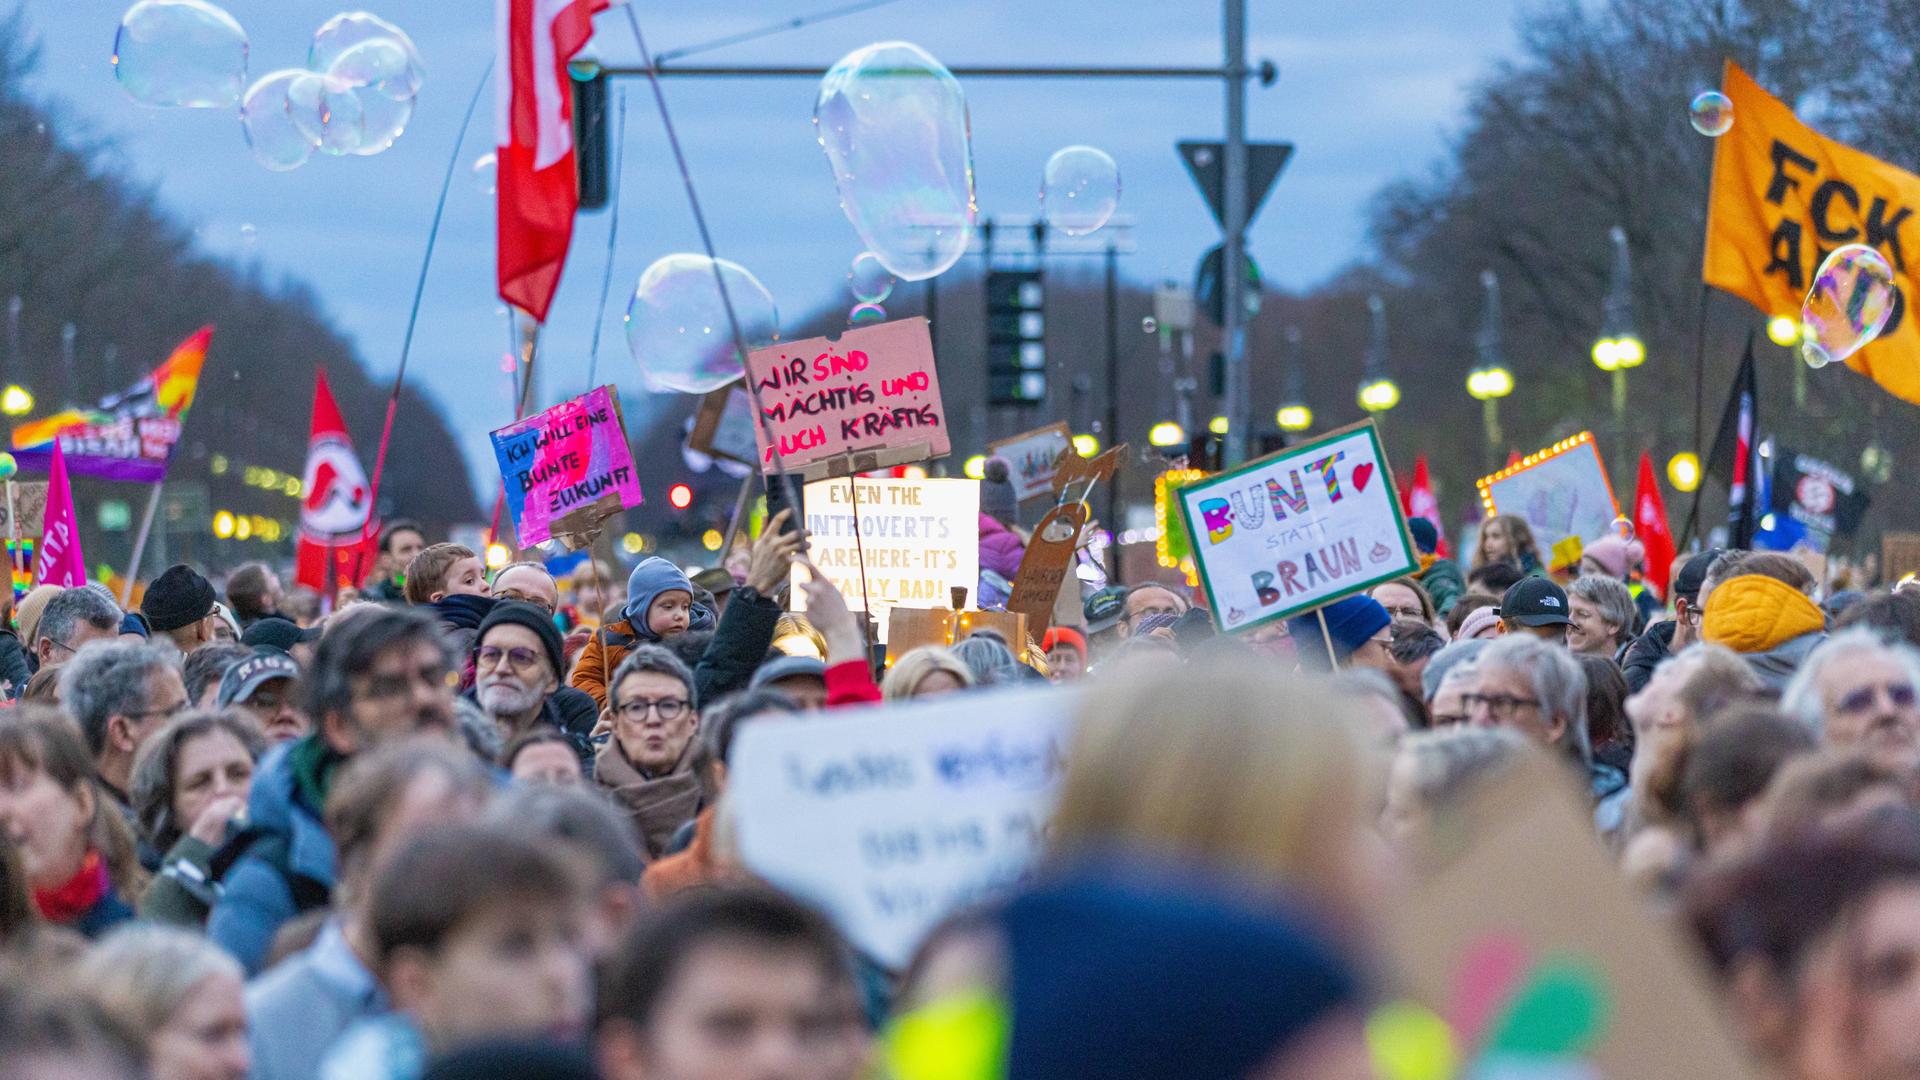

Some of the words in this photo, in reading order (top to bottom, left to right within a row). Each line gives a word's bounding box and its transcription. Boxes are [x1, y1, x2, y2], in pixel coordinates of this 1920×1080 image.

[1766, 138, 1914, 277] FCK
[753, 354, 809, 394] WIR
[812, 347, 869, 381] SIND
[760, 375, 875, 427] MÄCHTIG
[881, 371, 929, 396] UND
[841, 395, 939, 440] KRÄFTIG
[506, 442, 531, 464] ICH
[532, 423, 574, 449] WILL
[575, 408, 608, 431] EINE
[518, 451, 580, 493] BUNTE
[549, 466, 629, 512] ZUKUNFT
[830, 485, 880, 505] EVEN
[887, 486, 922, 506] THE
[1198, 451, 1346, 545] BUNT
[807, 514, 950, 538] INTROVERTS
[1265, 517, 1329, 549] STATT
[818, 548, 858, 567] ARE
[1250, 537, 1363, 607] BRAUN
[899, 579, 943, 600] BAD!
